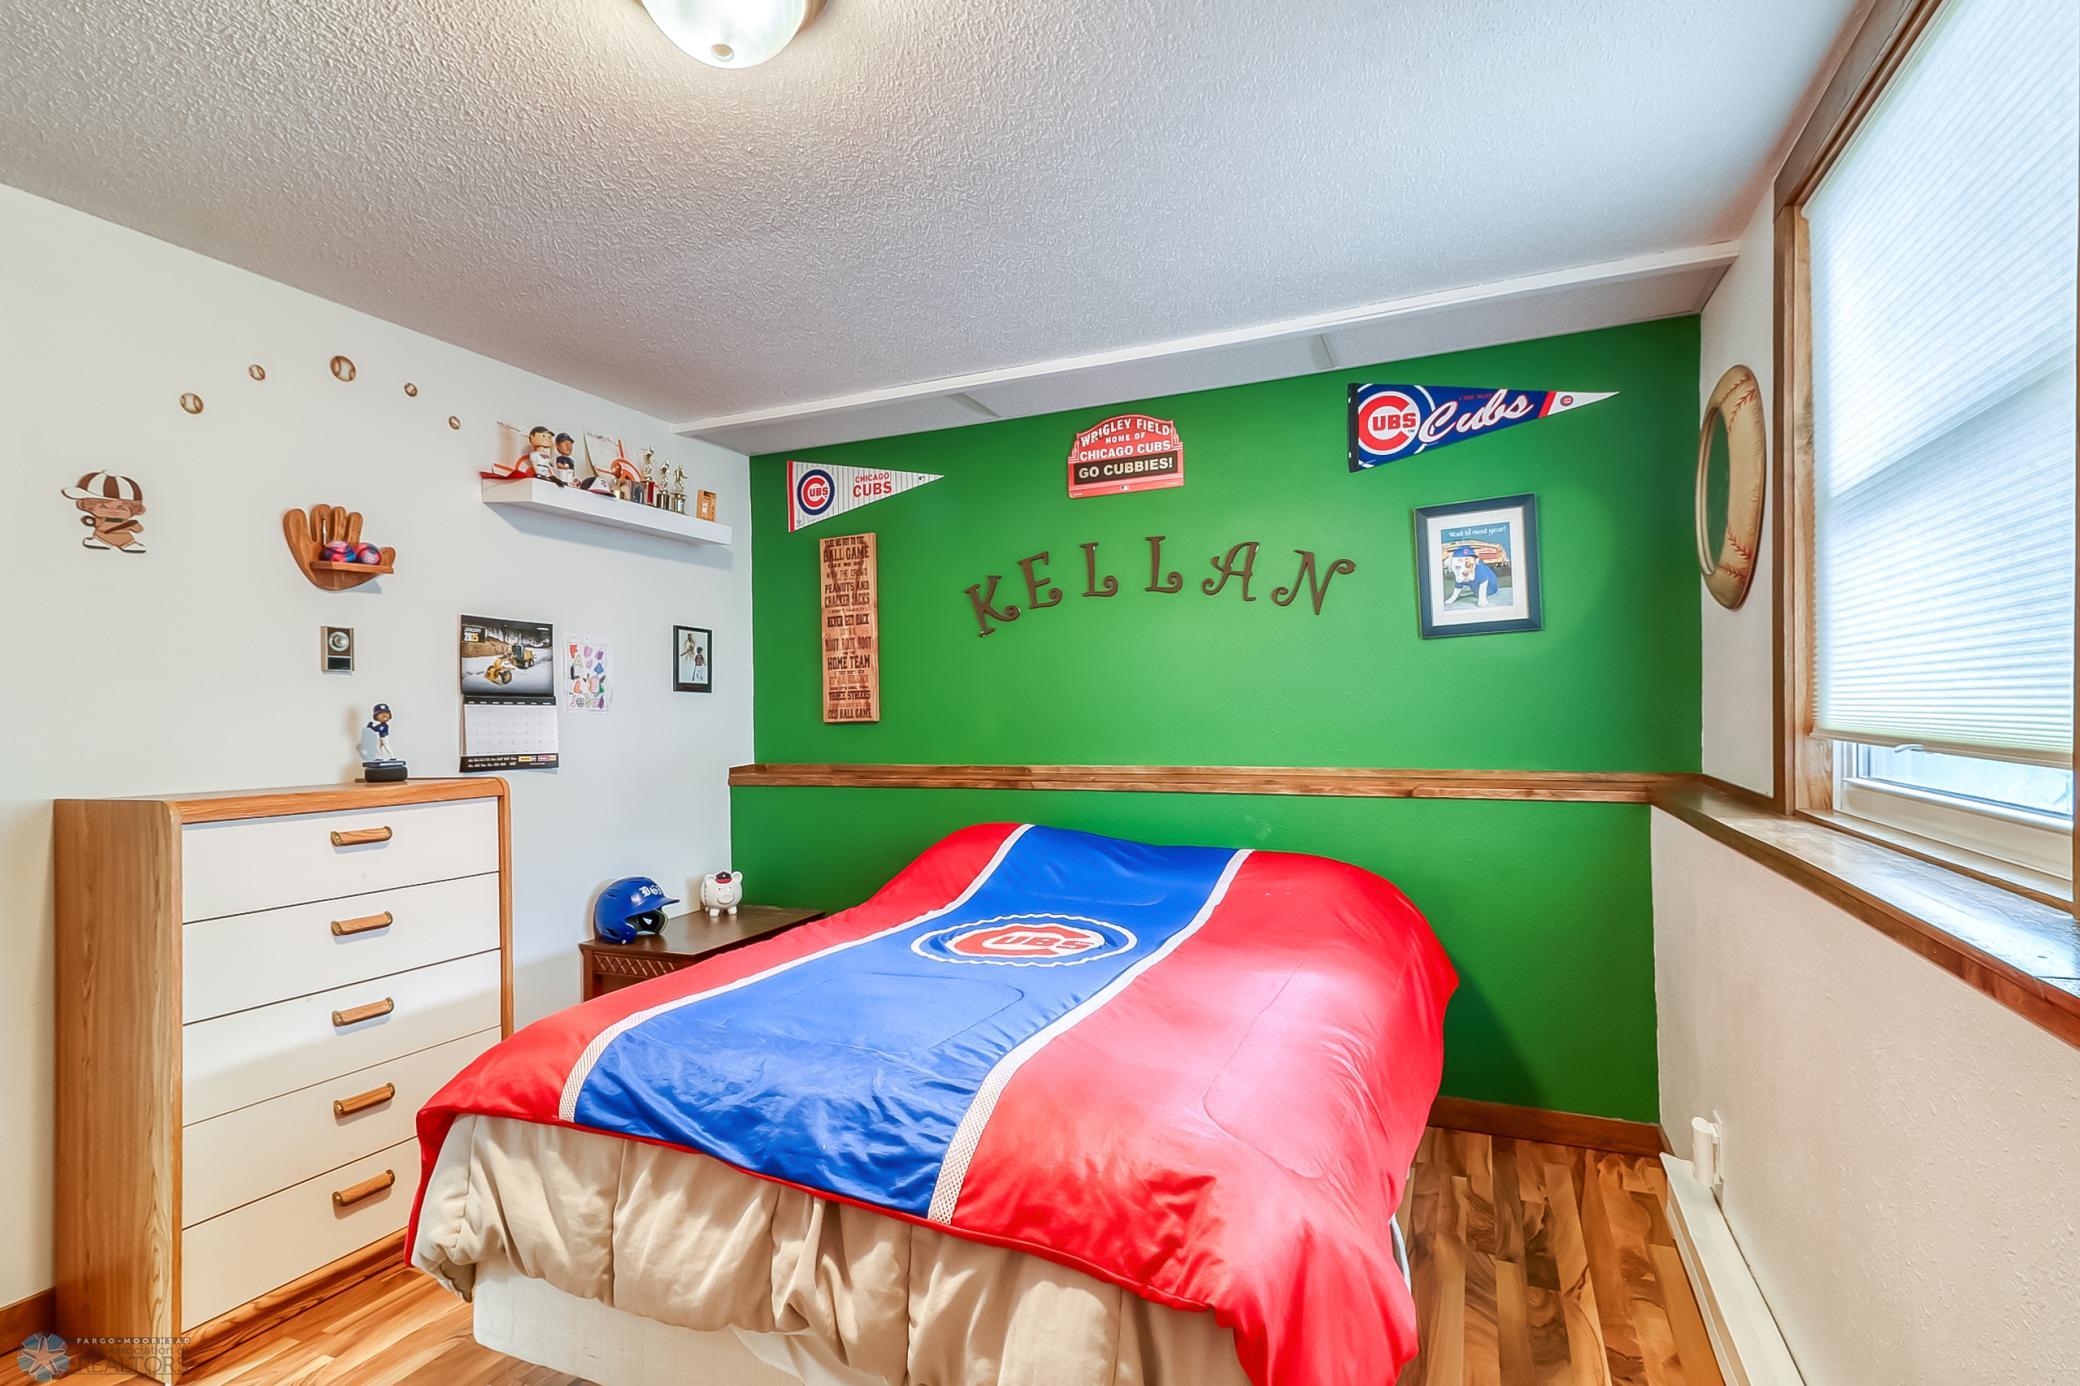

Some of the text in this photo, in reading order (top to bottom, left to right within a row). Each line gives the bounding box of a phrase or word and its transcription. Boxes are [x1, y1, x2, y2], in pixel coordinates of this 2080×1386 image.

[1419, 389, 1534, 443] Cubs
[1080, 418, 1171, 447] WRIGLEY FIELD
[1105, 434, 1131, 444] HOME
[1079, 440, 1171, 461] CHICAGO CUBS
[854, 471, 890, 483] CHICAGO
[1079, 456, 1173, 479] GO CUBBIES!
[852, 481, 893, 498] CUBS
[823, 545, 870, 563] BALL GAME
[964, 535, 1358, 638] KELLAN
[827, 654, 870, 670] HOME TEAM
